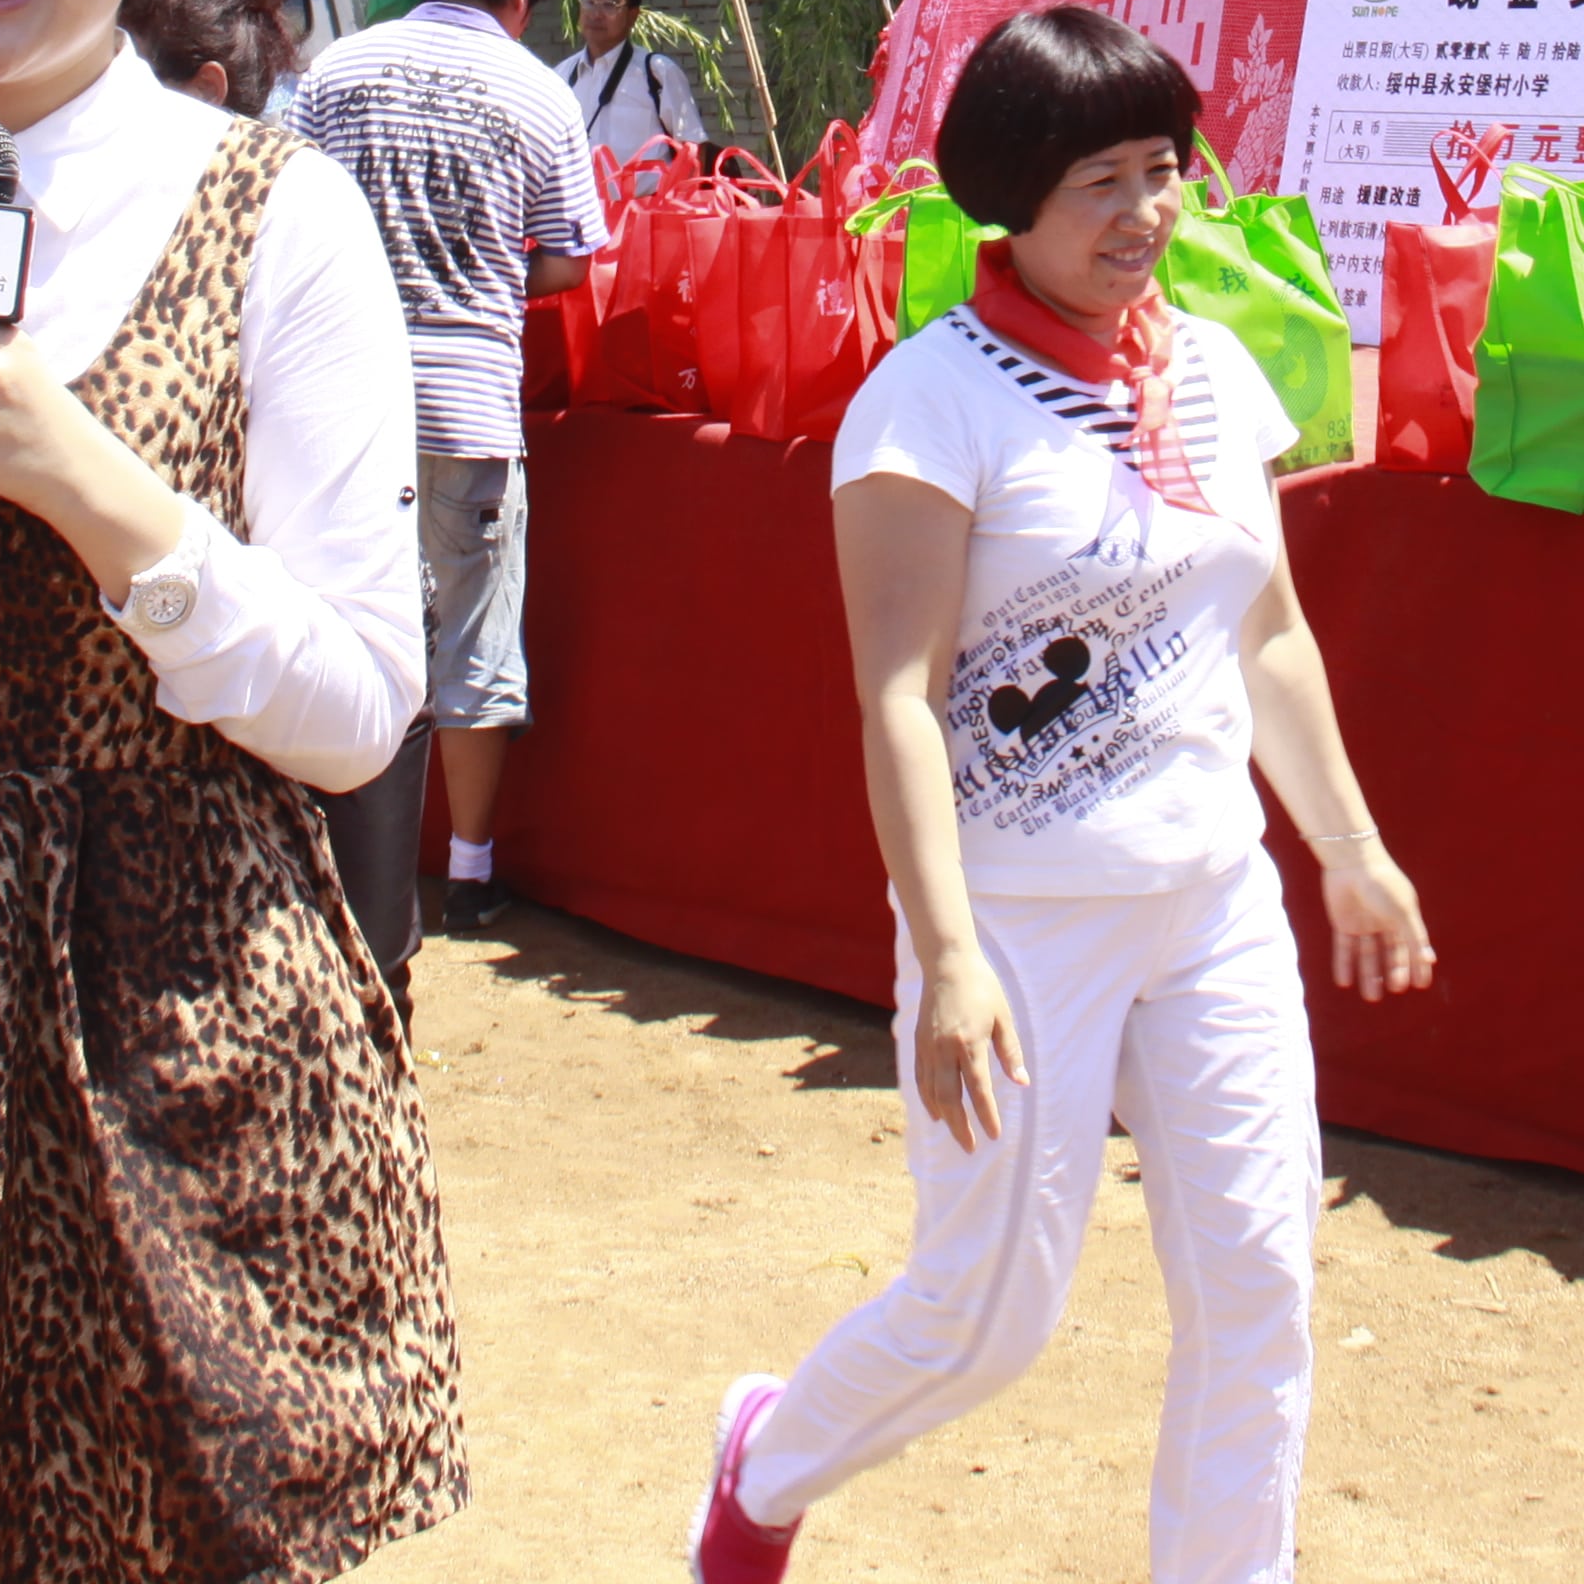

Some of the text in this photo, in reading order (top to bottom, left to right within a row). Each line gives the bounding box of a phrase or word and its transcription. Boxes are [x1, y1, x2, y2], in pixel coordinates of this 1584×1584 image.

[1351, 5, 1399, 17] SUN HOPE
[1384, 71, 1551, 98] 绥中县永安堡村小学
[1334, 119, 1382, 136] 人民币
[1319, 185, 1422, 208] 用途 援建改造
[1334, 287, 1368, 307] 签章
